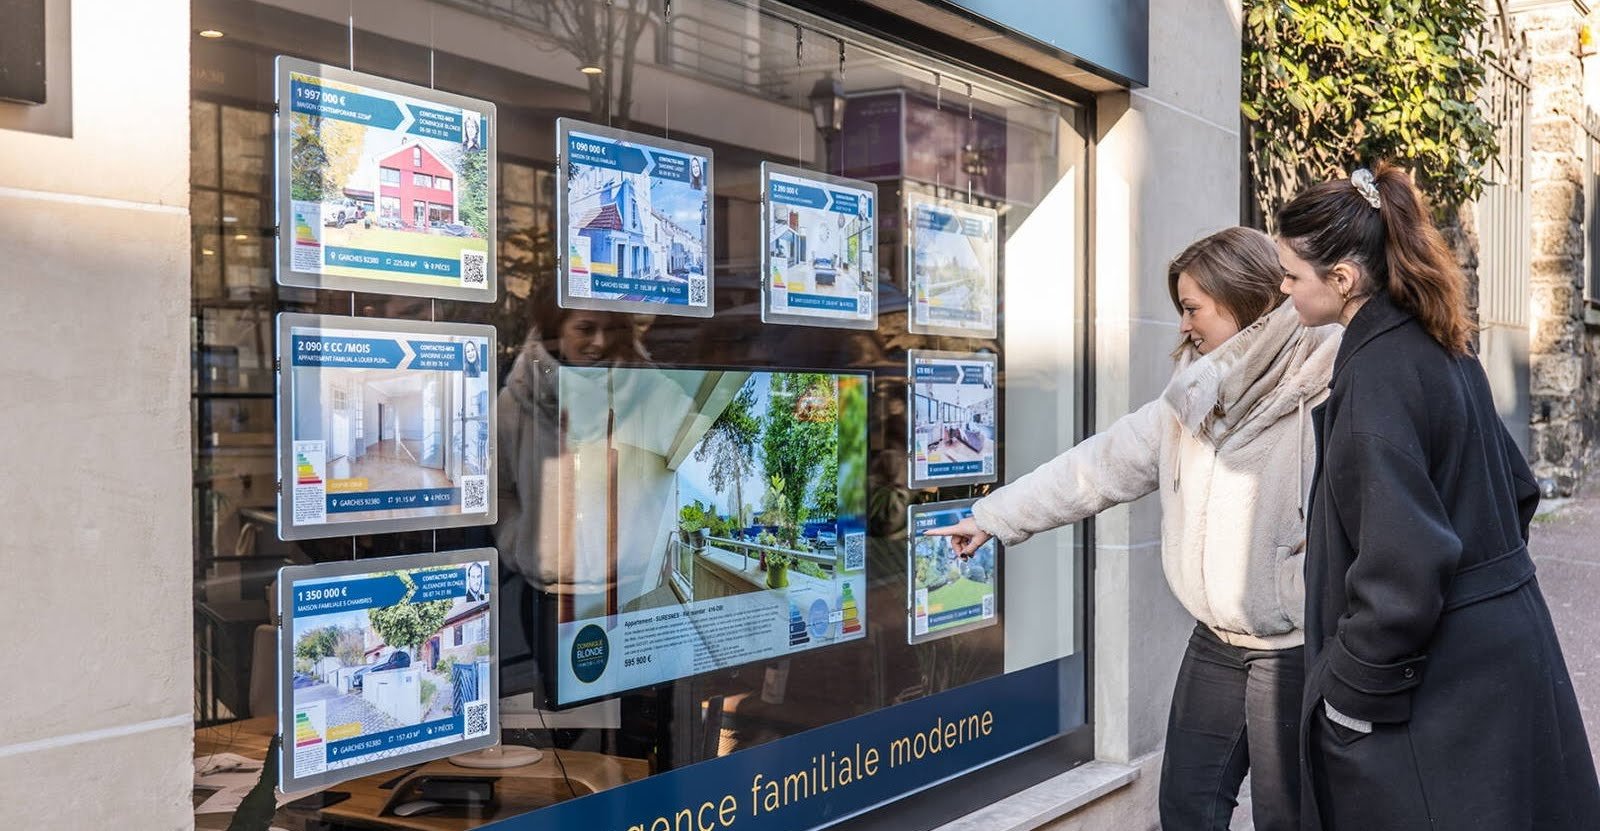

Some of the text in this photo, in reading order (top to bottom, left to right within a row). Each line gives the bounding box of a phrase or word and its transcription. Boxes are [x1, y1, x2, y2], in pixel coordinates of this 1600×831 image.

[296, 88, 346, 106] 1 997 000 €
[571, 141, 575, 149] 1
[589, 144, 600, 154] 000
[298, 341, 371, 353] 2 090 € CC /MOIS
[298, 586, 347, 602] 1 350 000 €
[318, 601, 342, 609] FAMILIALE
[347, 597, 373, 606] CHAMBRES
[625, 617, 653, 628] Appartement
[656, 612, 680, 621] SURESNES
[577, 640, 603, 649] DOMINIQUE
[577, 646, 604, 658] BLONDE
[340, 744, 365, 754] GARCHES
[439, 723, 454, 733] PIÈCES
[752, 744, 880, 816] familiale
[890, 710, 993, 768] moderne
